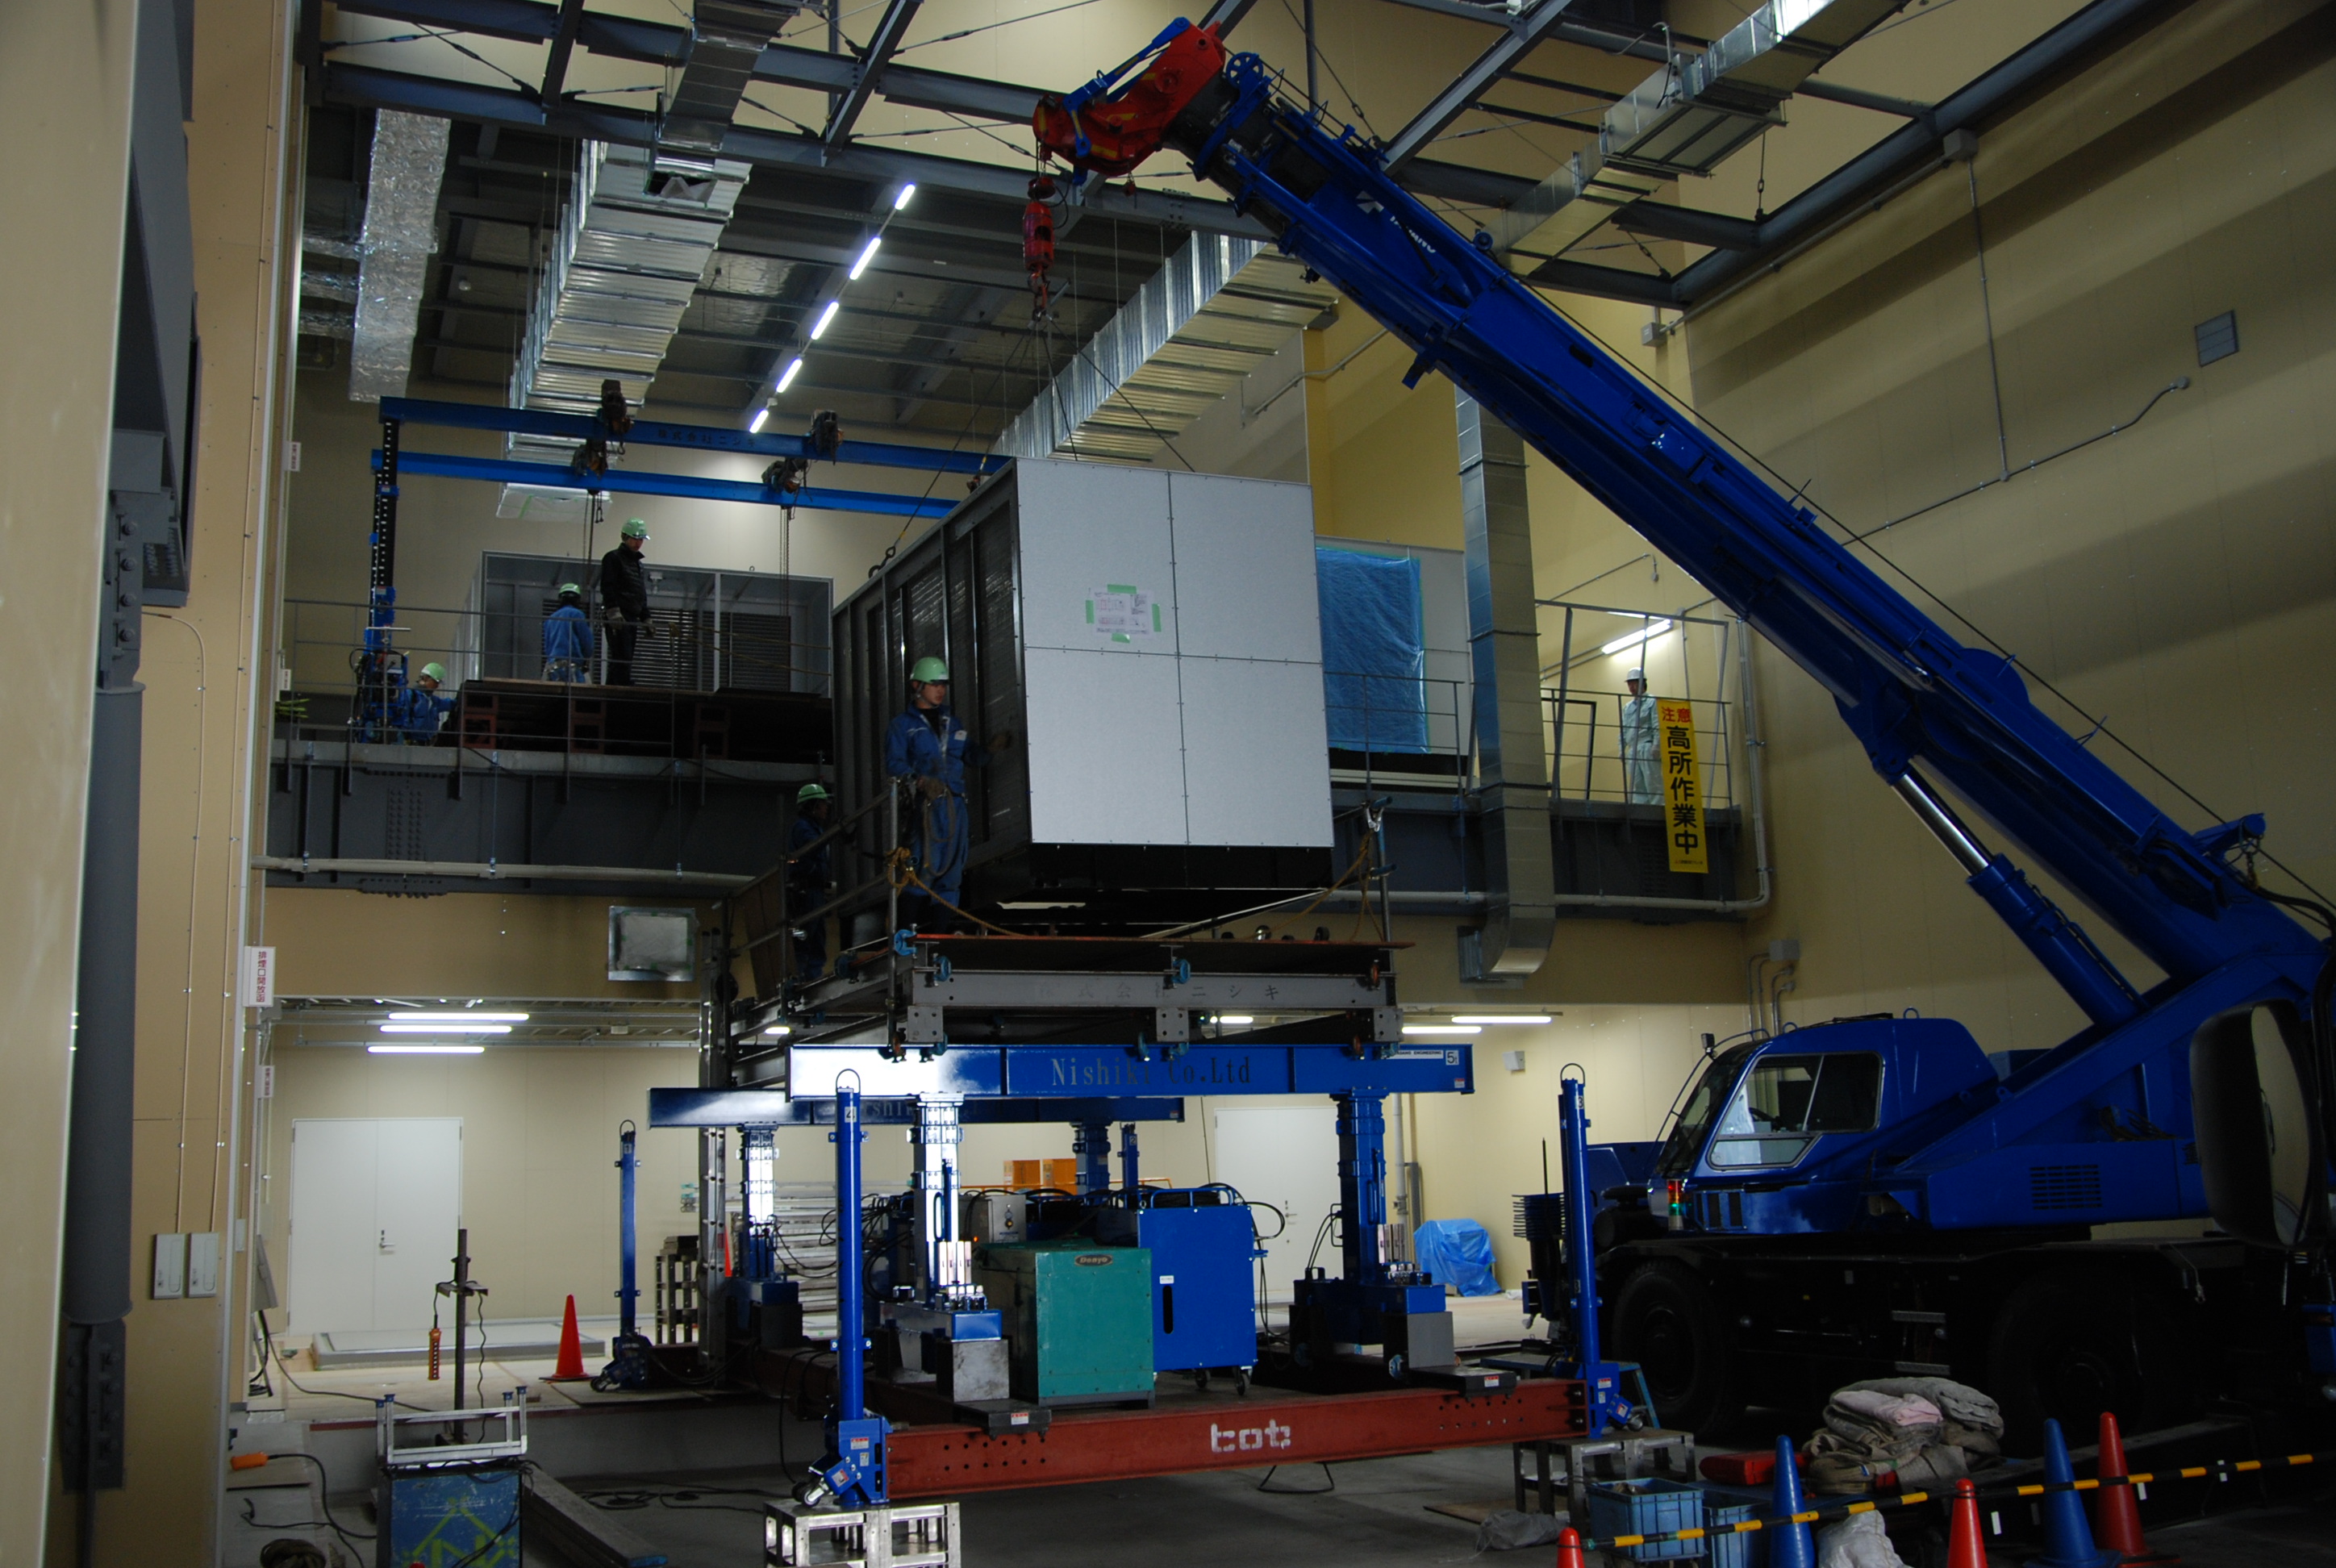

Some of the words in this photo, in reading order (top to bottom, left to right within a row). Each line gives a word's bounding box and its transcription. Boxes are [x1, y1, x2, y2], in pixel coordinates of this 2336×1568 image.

[1661, 706, 1692, 724] 注意
[1666, 725, 1699, 855] 高所作業中
[1050, 1056, 1150, 1086] Nishiki
[846, 1109, 855, 1120] 4
